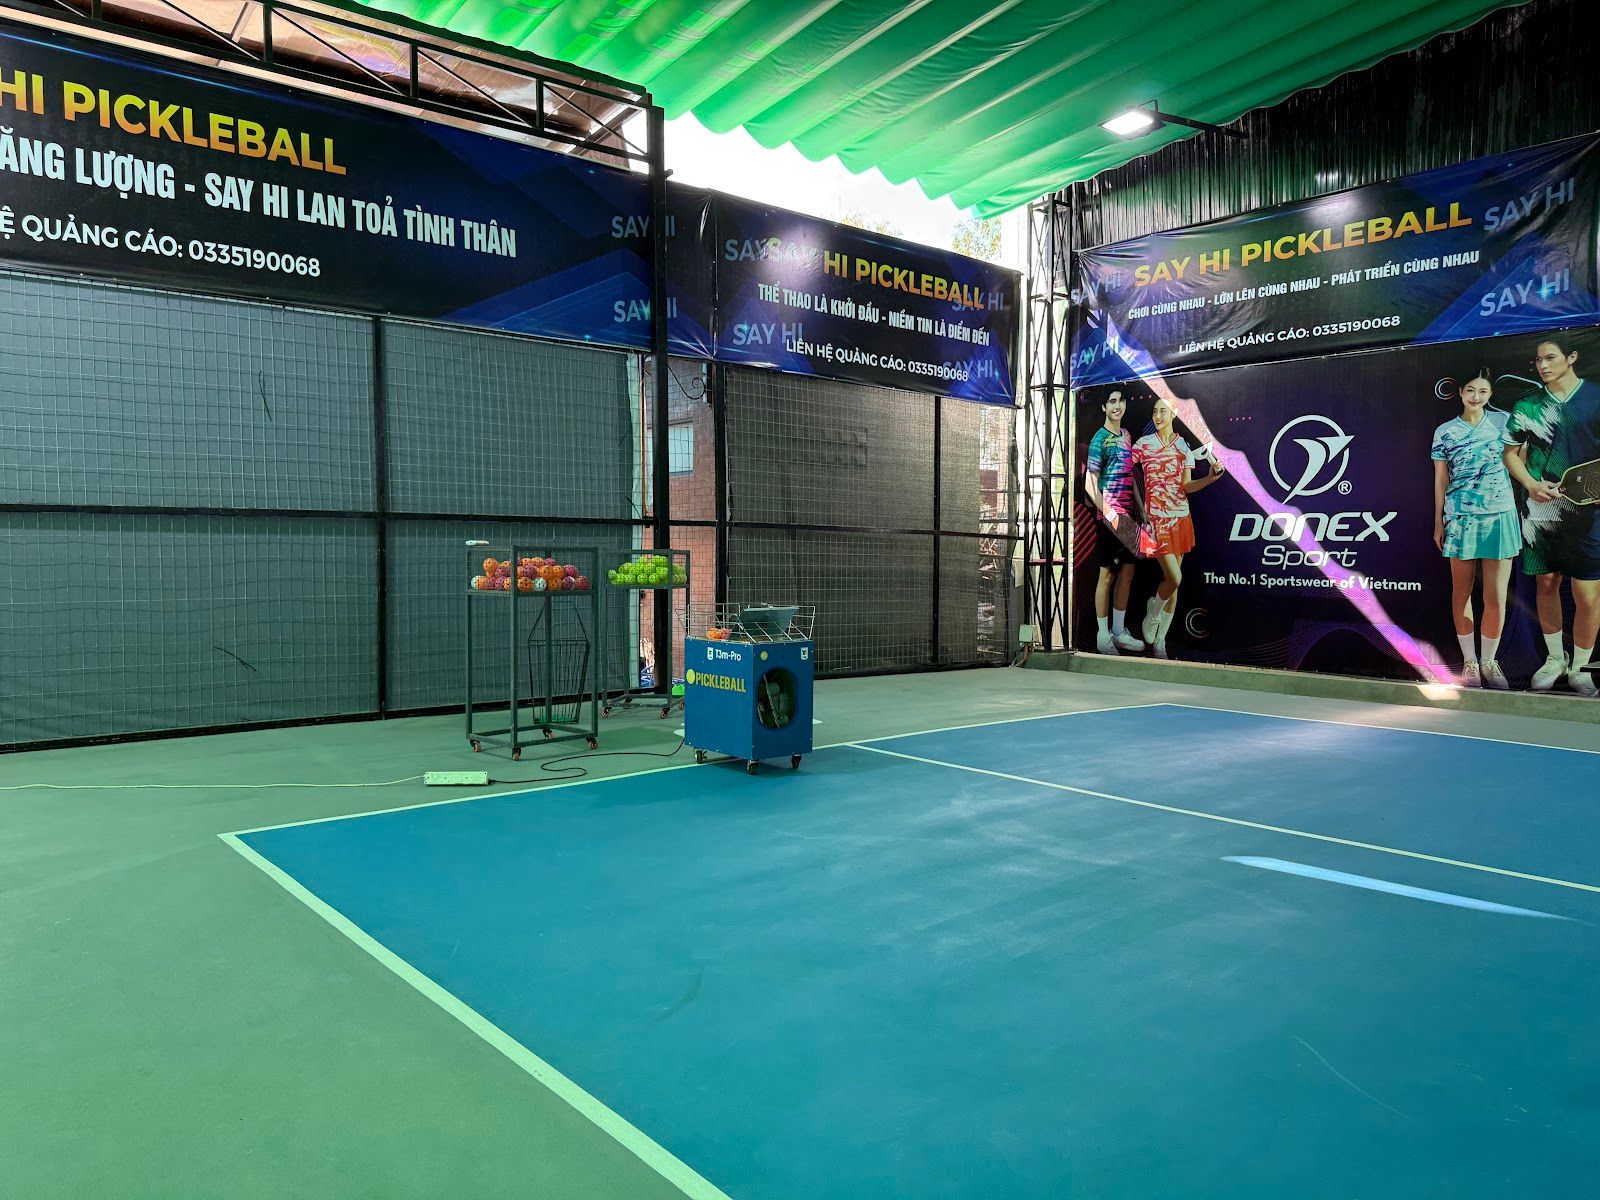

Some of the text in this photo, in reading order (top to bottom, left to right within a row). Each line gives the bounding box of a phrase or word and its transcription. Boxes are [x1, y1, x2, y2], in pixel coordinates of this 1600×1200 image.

[0, 67, 346, 175] HI PICKLEBALL
[75, 148, 175, 199] LƯỢNG
[205, 172, 254, 213] SAY
[262, 182, 288, 219] HI
[297, 188, 345, 229] LAN
[352, 195, 397, 237] TOẢ
[403, 204, 455, 247] TÌNH
[461, 218, 516, 258] THÂN
[1483, 177, 1575, 232] SAY HI
[21, 213, 118, 249] QUẢNG
[124, 227, 183, 258] CÁO:
[188, 239, 321, 277] 0335190068
[611, 215, 649, 238] SAY
[1134, 202, 1472, 287] SAY HI PICKLEBALL
[823, 250, 848, 279] HI
[855, 258, 985, 310] PICKLEBALL
[1104, 272, 1121, 292] HI
[1152, 301, 1177, 316] CÙNG
[1178, 297, 1205, 311] NHAU
[1214, 291, 1233, 305] LỚN
[1236, 287, 1255, 301] LÊN
[1258, 282, 1287, 298] CÙNG
[1290, 277, 1320, 293] NHAU
[1331, 269, 1361, 286] PHÁT
[1364, 260, 1400, 281] TRIỂN
[1403, 258, 1439, 274] CÙNG
[1442, 250, 1480, 268] NHAU
[1479, 267, 1570, 317] SAY HI
[613, 299, 651, 322] SAY
[758, 281, 780, 304] THỂ
[783, 288, 811, 310] THAO
[814, 293, 828, 314] LÀ
[830, 297, 856, 319] KHỞI
[858, 301, 879, 324] ĐẦU
[917, 316, 932, 335] TIN
[934, 319, 947, 337] LÀ
[948, 320, 970, 342] ĐIỂM
[972, 326, 990, 346] ĐẾN
[733, 322, 803, 346] SAY HI
[1206, 338, 1225, 351] HỆ
[1227, 332, 1275, 348] QUẢNG
[1277, 326, 1310, 341] CÁO:
[1312, 315, 1400, 337] 0335190068
[786, 338, 968, 382] LIÊN HỆ QUẢNG CÁO: 0335190068
[977, 360, 993, 378] HI
[1261, 545, 1357, 570] Sport
[1204, 572, 1422, 591] The No.1 Sportswear of Vietnam
[715, 648, 742, 662] T3m-Pro
[695, 672, 747, 693] PICKLEBALL
